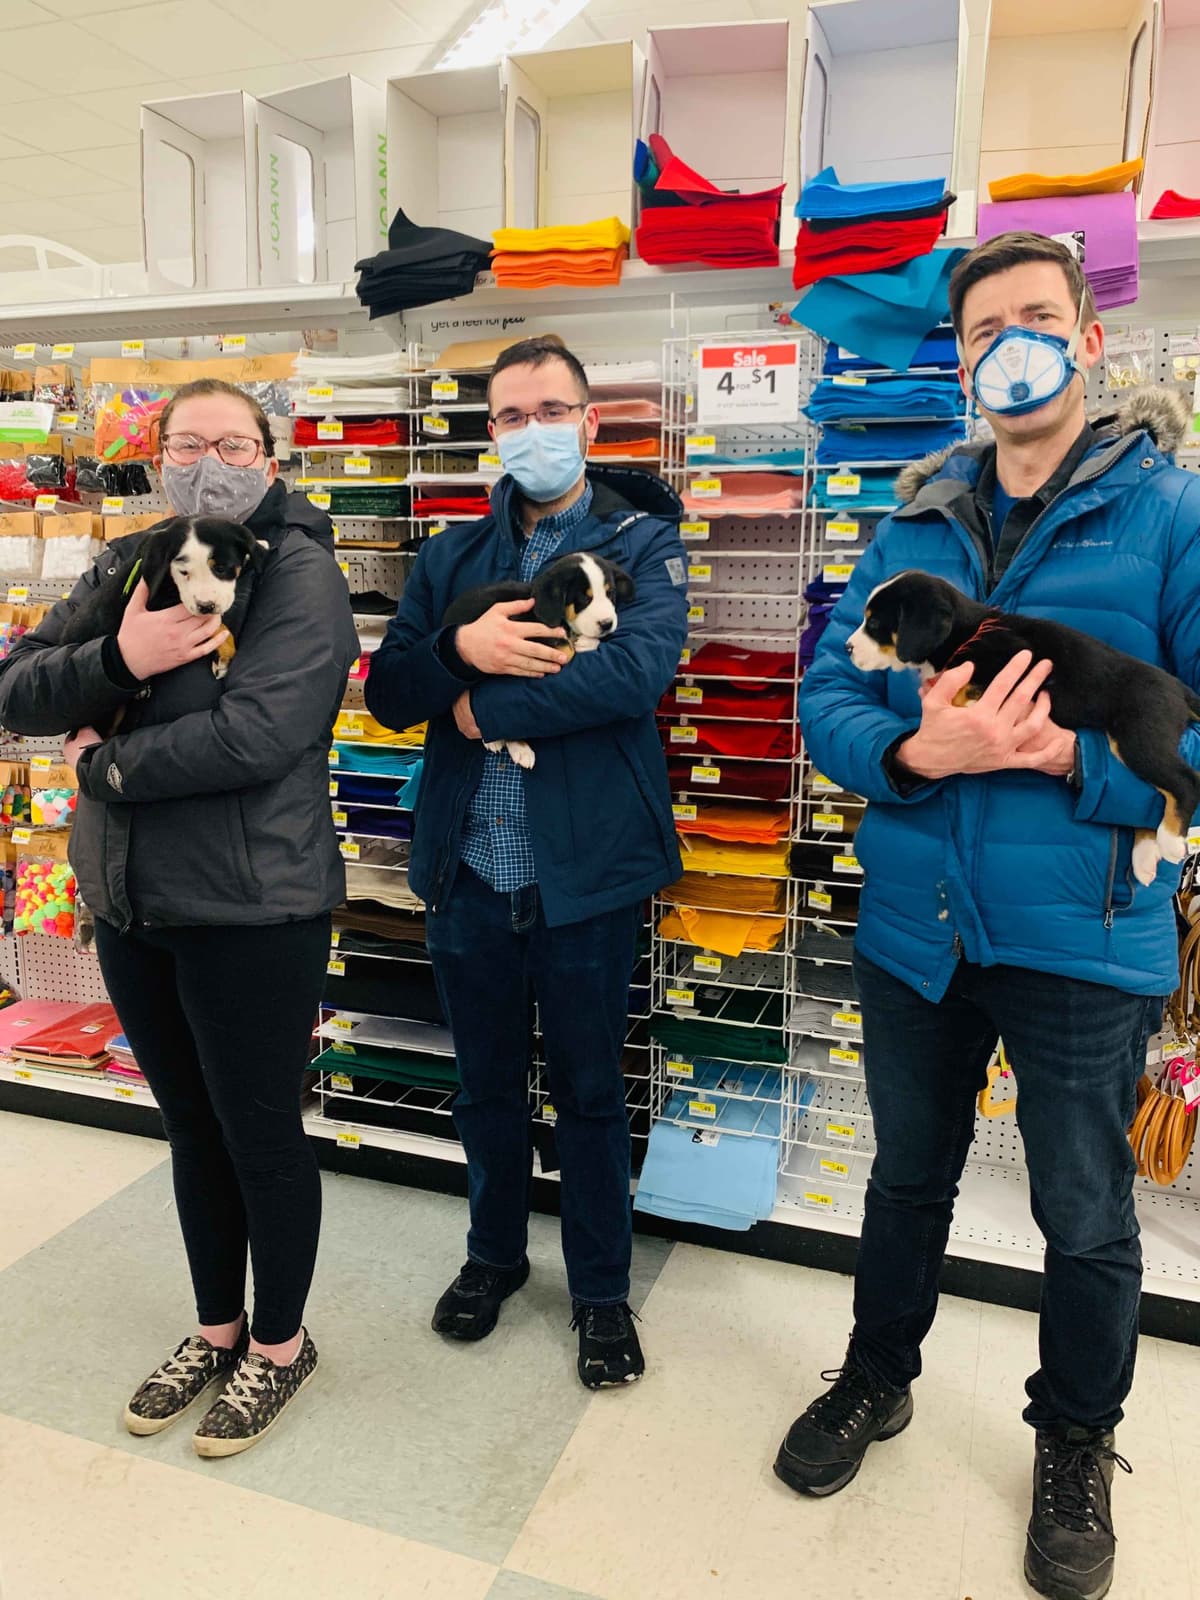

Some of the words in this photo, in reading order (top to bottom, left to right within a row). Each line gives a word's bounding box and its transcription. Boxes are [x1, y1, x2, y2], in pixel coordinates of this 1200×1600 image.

[269, 152, 281, 258] JOANN
[733, 349, 767, 368] Sale
[717, 371, 735, 396] 4
